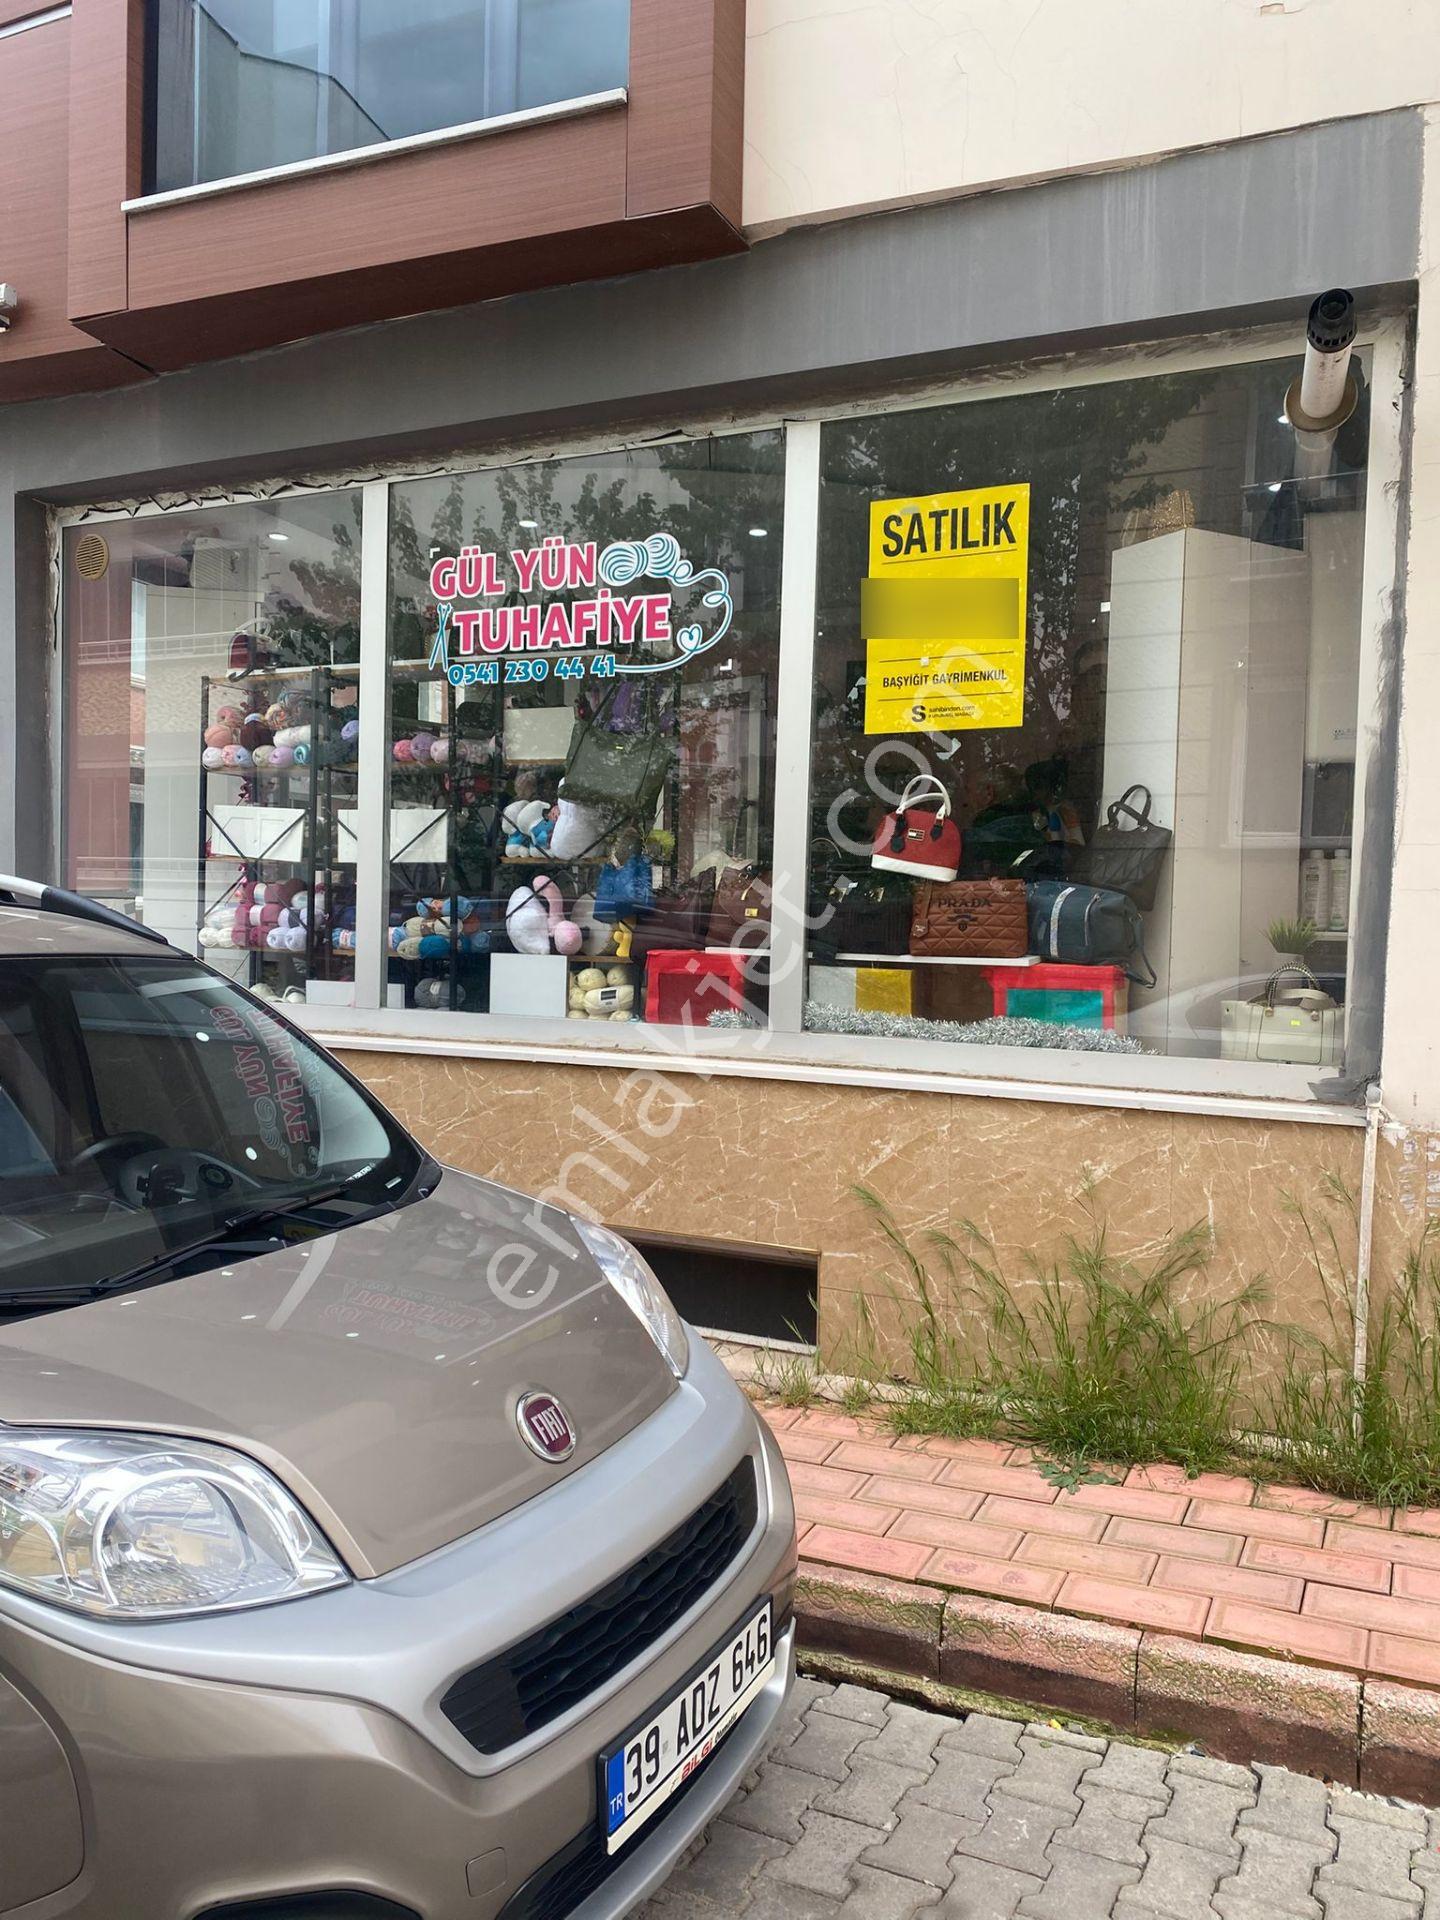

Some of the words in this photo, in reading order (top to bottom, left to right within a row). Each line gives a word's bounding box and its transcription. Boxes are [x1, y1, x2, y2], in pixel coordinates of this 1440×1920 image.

[883, 501, 1016, 557] SATILIK
[431, 545, 505, 599] GÜL
[513, 536, 596, 592] YÜN
[453, 589, 672, 655] TUHAFİYE
[448, 660, 498, 686] 0541
[505, 658, 548, 683] 230
[554, 656, 584, 680] 44
[590, 654, 616, 678] 41
[883, 674, 929, 690] BAŞYİĞİT
[932, 669, 1007, 685] GAYRİMENKUL
[530, 1405, 566, 1445] FIAT
[626, 1725, 660, 1804] 39
[676, 1663, 721, 1756] ADZ
[731, 1613, 768, 1693] 646
[610, 1793, 623, 1815] TR
